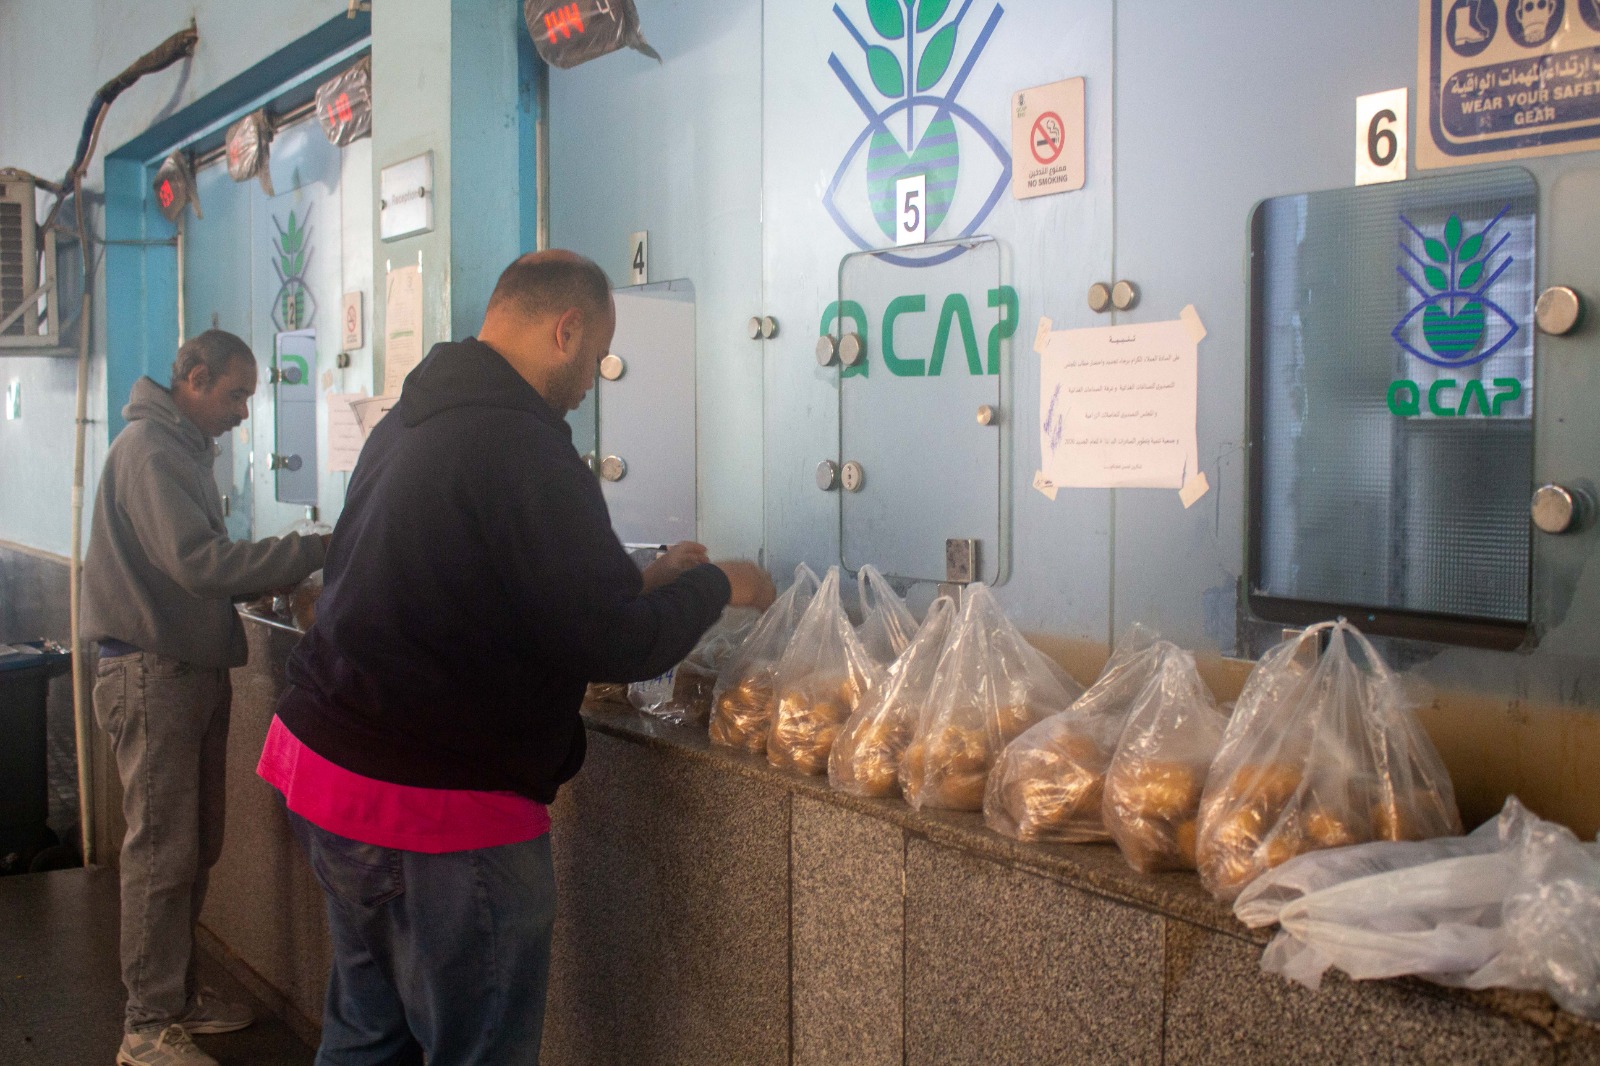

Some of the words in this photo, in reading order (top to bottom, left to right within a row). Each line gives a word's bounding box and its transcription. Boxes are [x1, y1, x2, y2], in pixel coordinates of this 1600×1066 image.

[1451, 71, 1496, 98] الواقية
[1461, 97, 1503, 114] WEAR
[1507, 88, 1549, 106] YOUR
[1514, 106, 1556, 126] GEAR
[1367, 108, 1398, 168] 6
[1027, 179, 1038, 188] NO
[1038, 174, 1068, 186] SMOKING
[1028, 166, 1049, 179] التدخين
[1049, 165, 1067, 176] ممنوع
[903, 190, 920, 233] 5
[633, 241, 645, 275] 4
[289, 302, 295, 325] 2
[1386, 377, 1521, 417] QCAP
